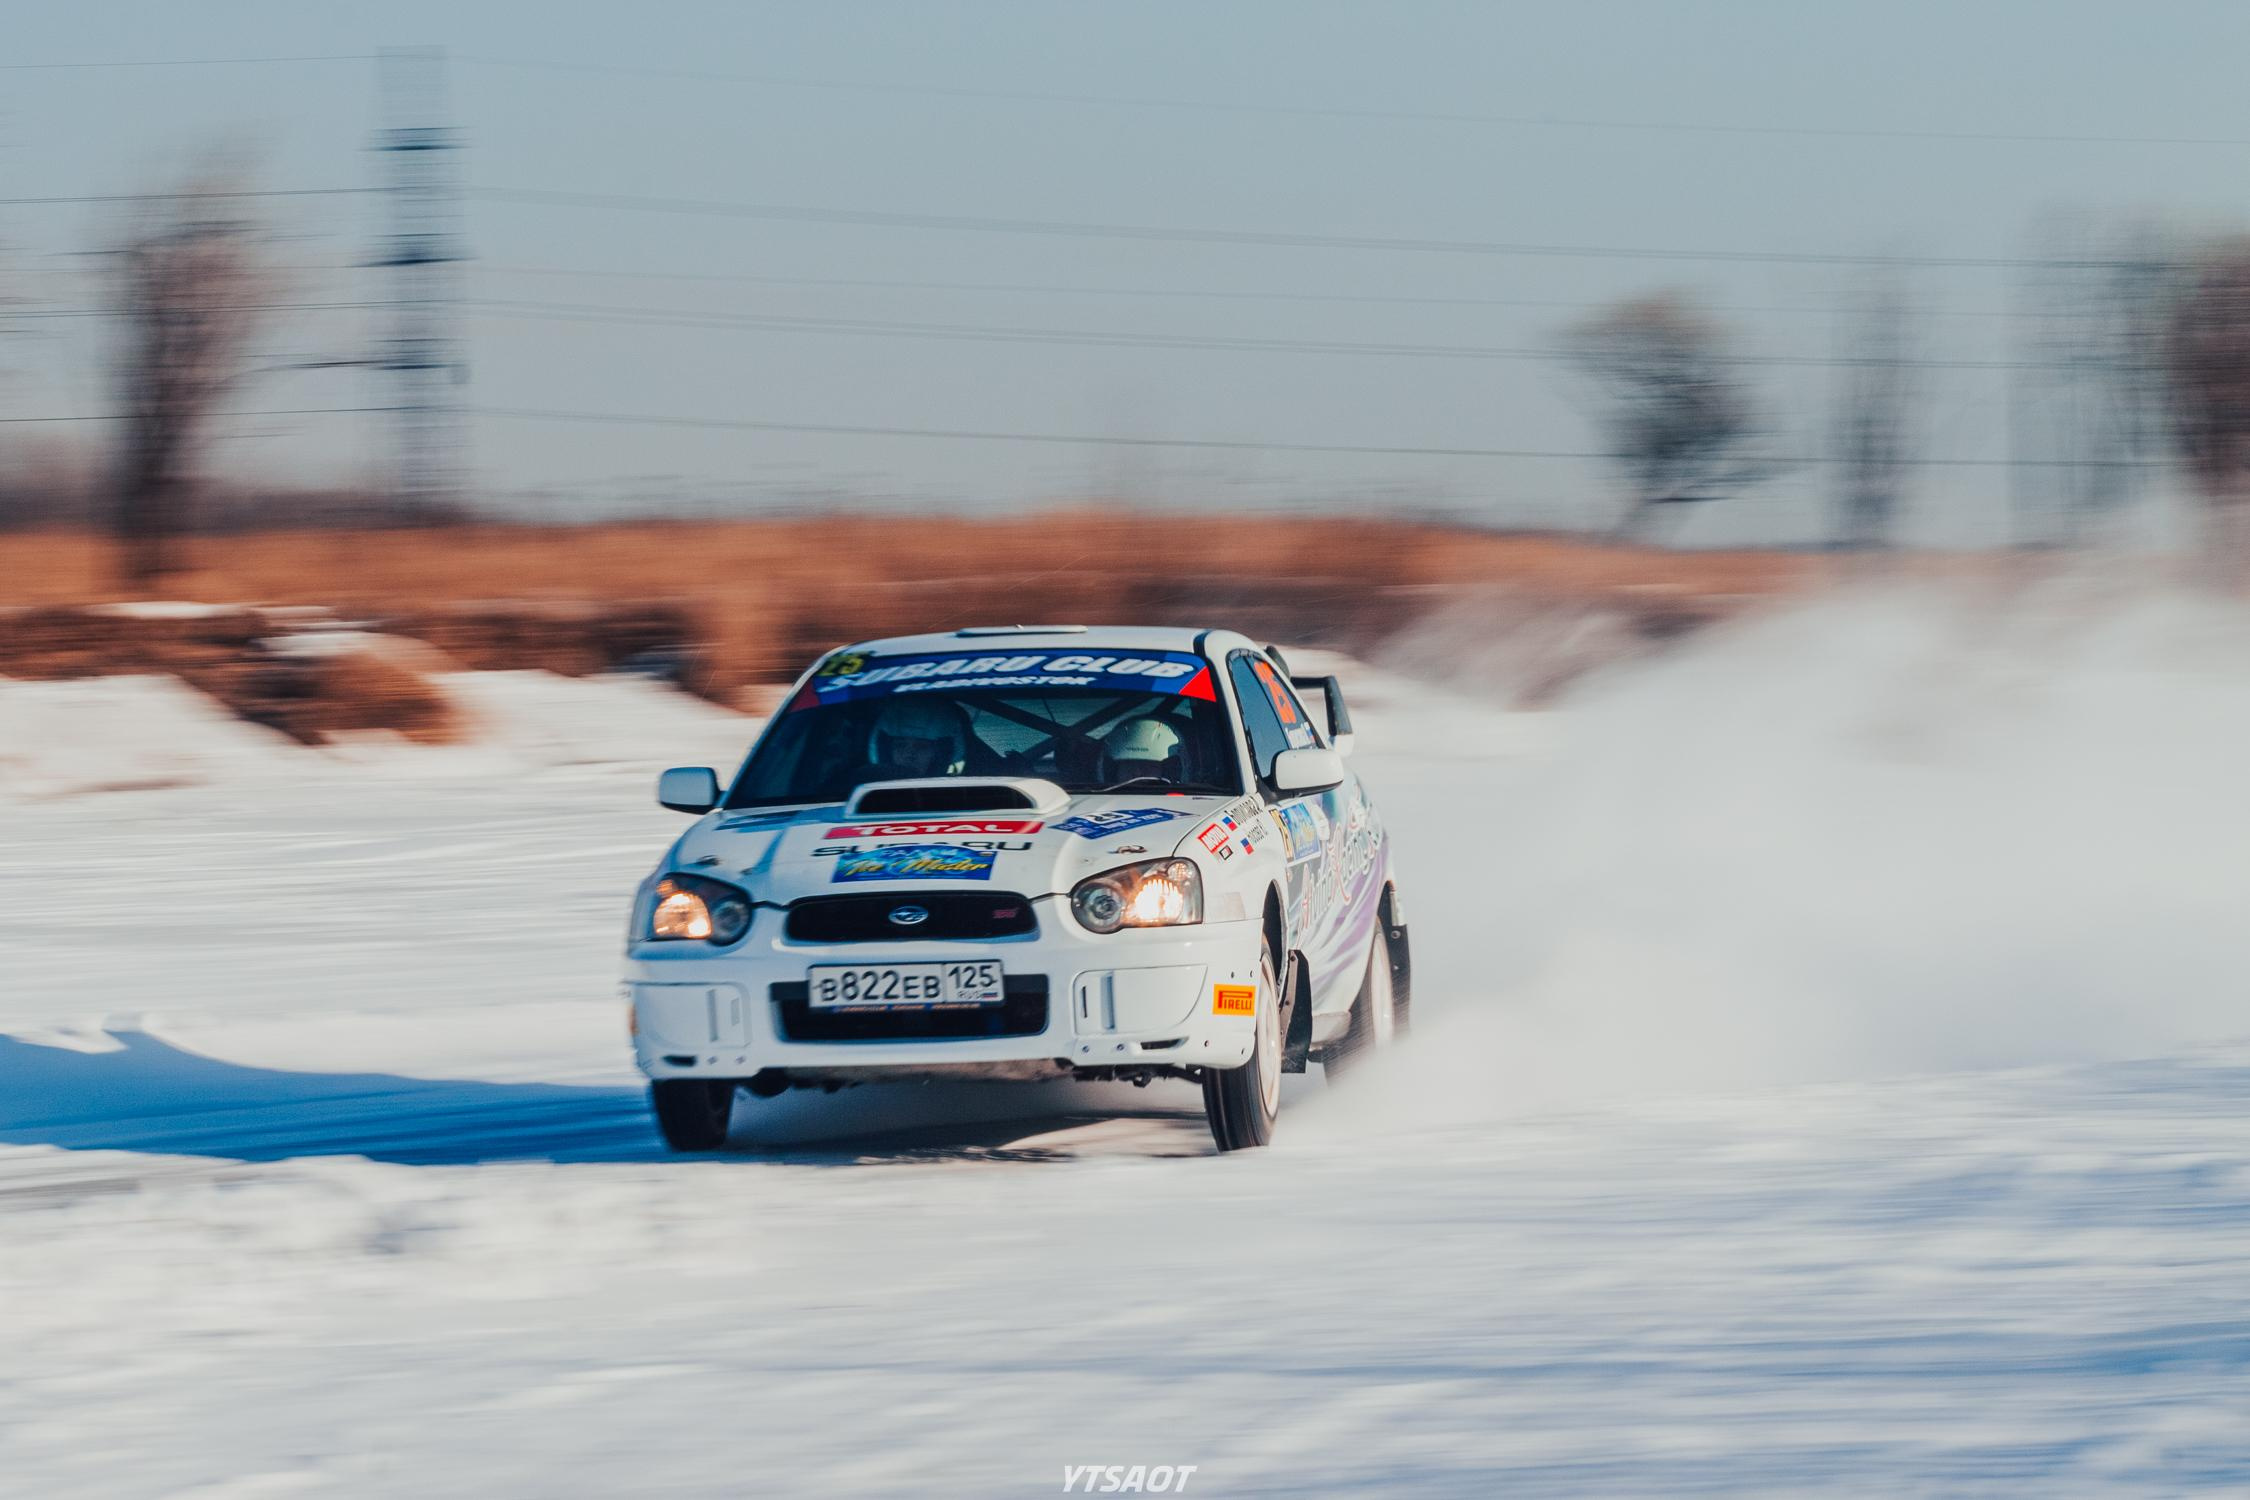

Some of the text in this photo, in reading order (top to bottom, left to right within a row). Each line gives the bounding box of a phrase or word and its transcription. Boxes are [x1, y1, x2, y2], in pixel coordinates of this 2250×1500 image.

[816, 655, 1195, 693] SUBARU CLUB
[850, 824, 1013, 836] TOTAL
[811, 841, 1033, 857] SURU
[948, 965, 994, 988] 125
[1218, 990, 1252, 1010] PIRELLI
